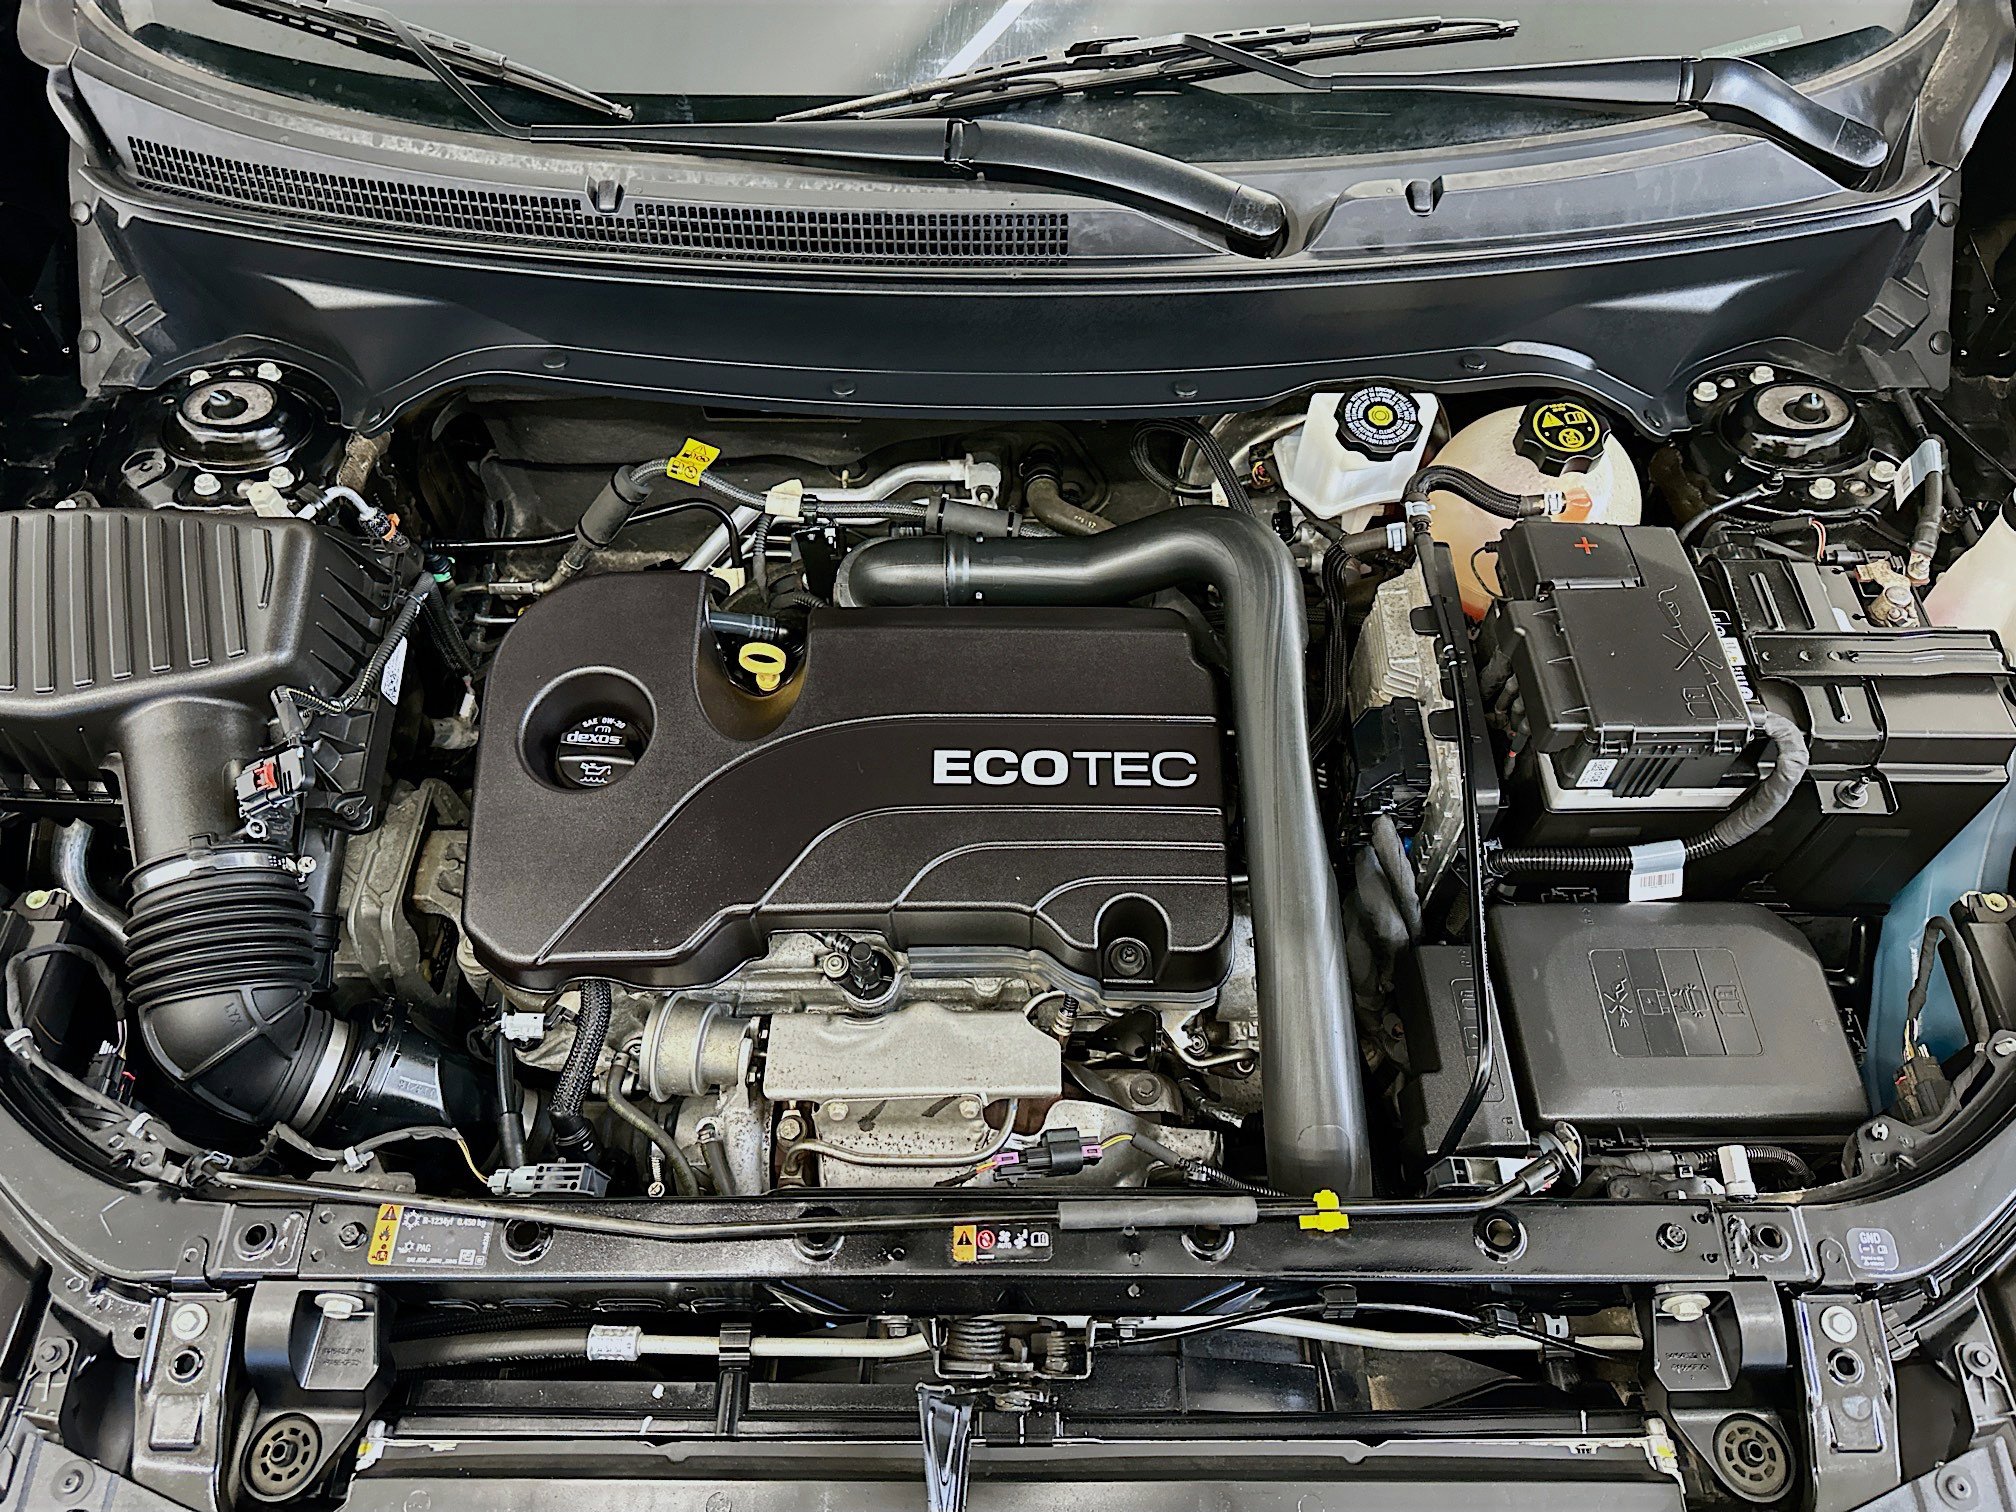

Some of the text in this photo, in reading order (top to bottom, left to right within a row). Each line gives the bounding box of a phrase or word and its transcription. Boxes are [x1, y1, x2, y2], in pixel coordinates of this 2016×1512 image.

[582, 717, 627, 729] SAE 0W-20
[566, 730, 623, 745] dexos
[932, 749, 1198, 787] ECOTEC
[477, 1218, 487, 1229] kg
[1858, 1231, 1882, 1245] GND
[416, 1243, 431, 1254] PAG
